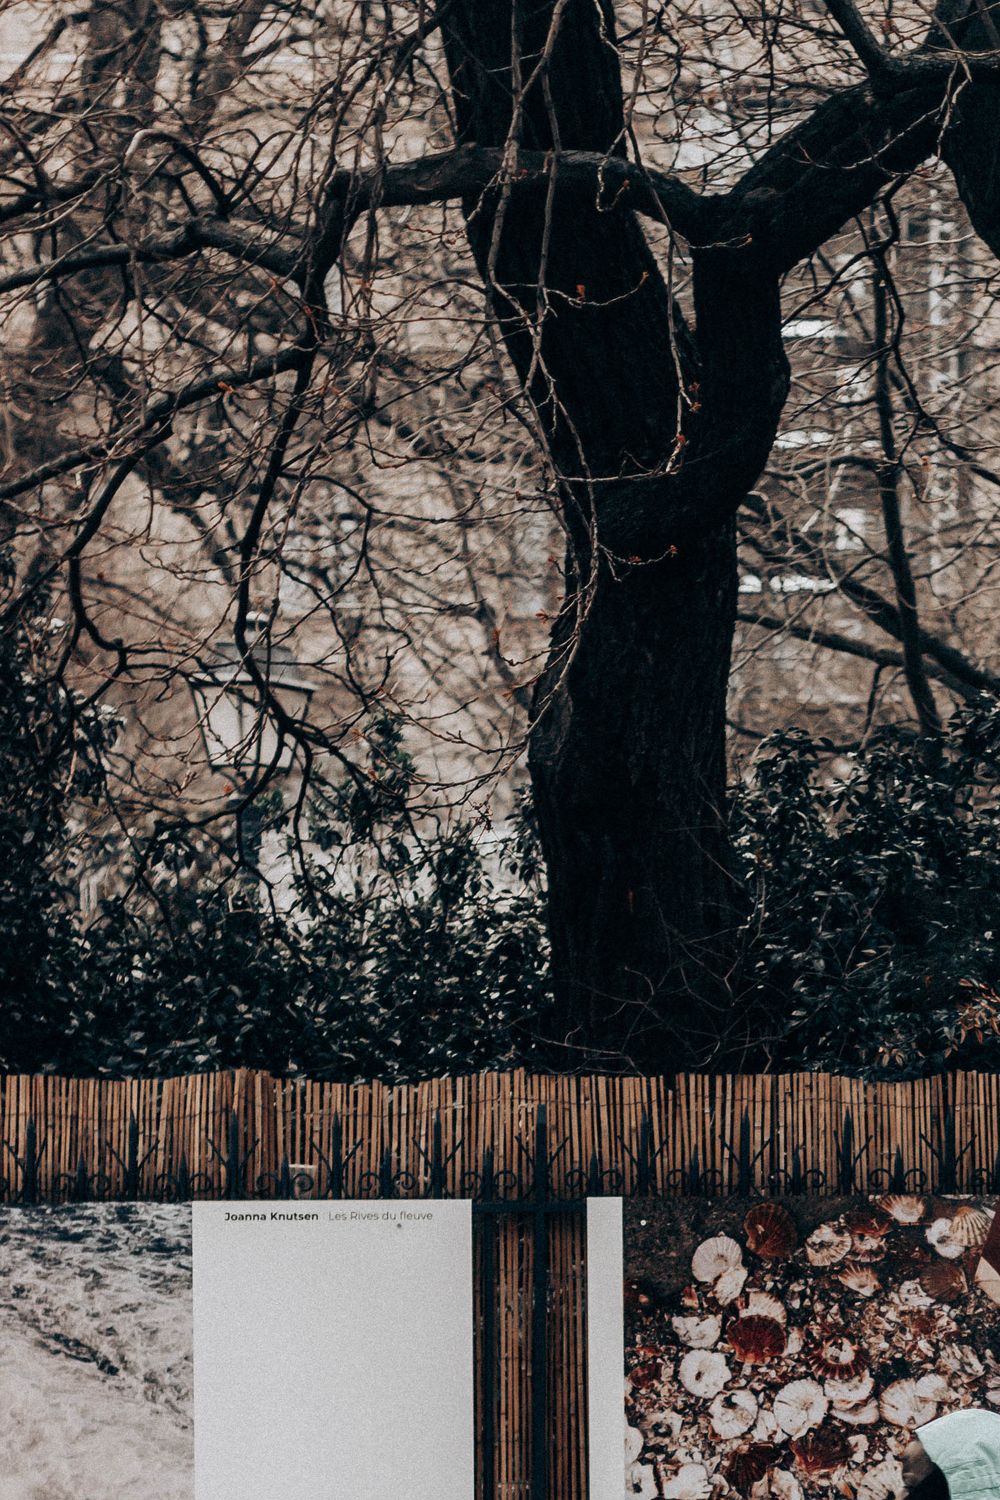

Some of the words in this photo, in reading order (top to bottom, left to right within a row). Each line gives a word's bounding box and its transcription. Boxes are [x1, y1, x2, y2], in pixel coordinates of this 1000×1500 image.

[225, 1212, 266, 1221] Joanna
[270, 1211, 319, 1221] Knutsen
[328, 1211, 347, 1221] Les
[350, 1211, 379, 1221] Rives
[381, 1211, 397, 1221] du
[399, 1211, 433, 1221] fleuve
